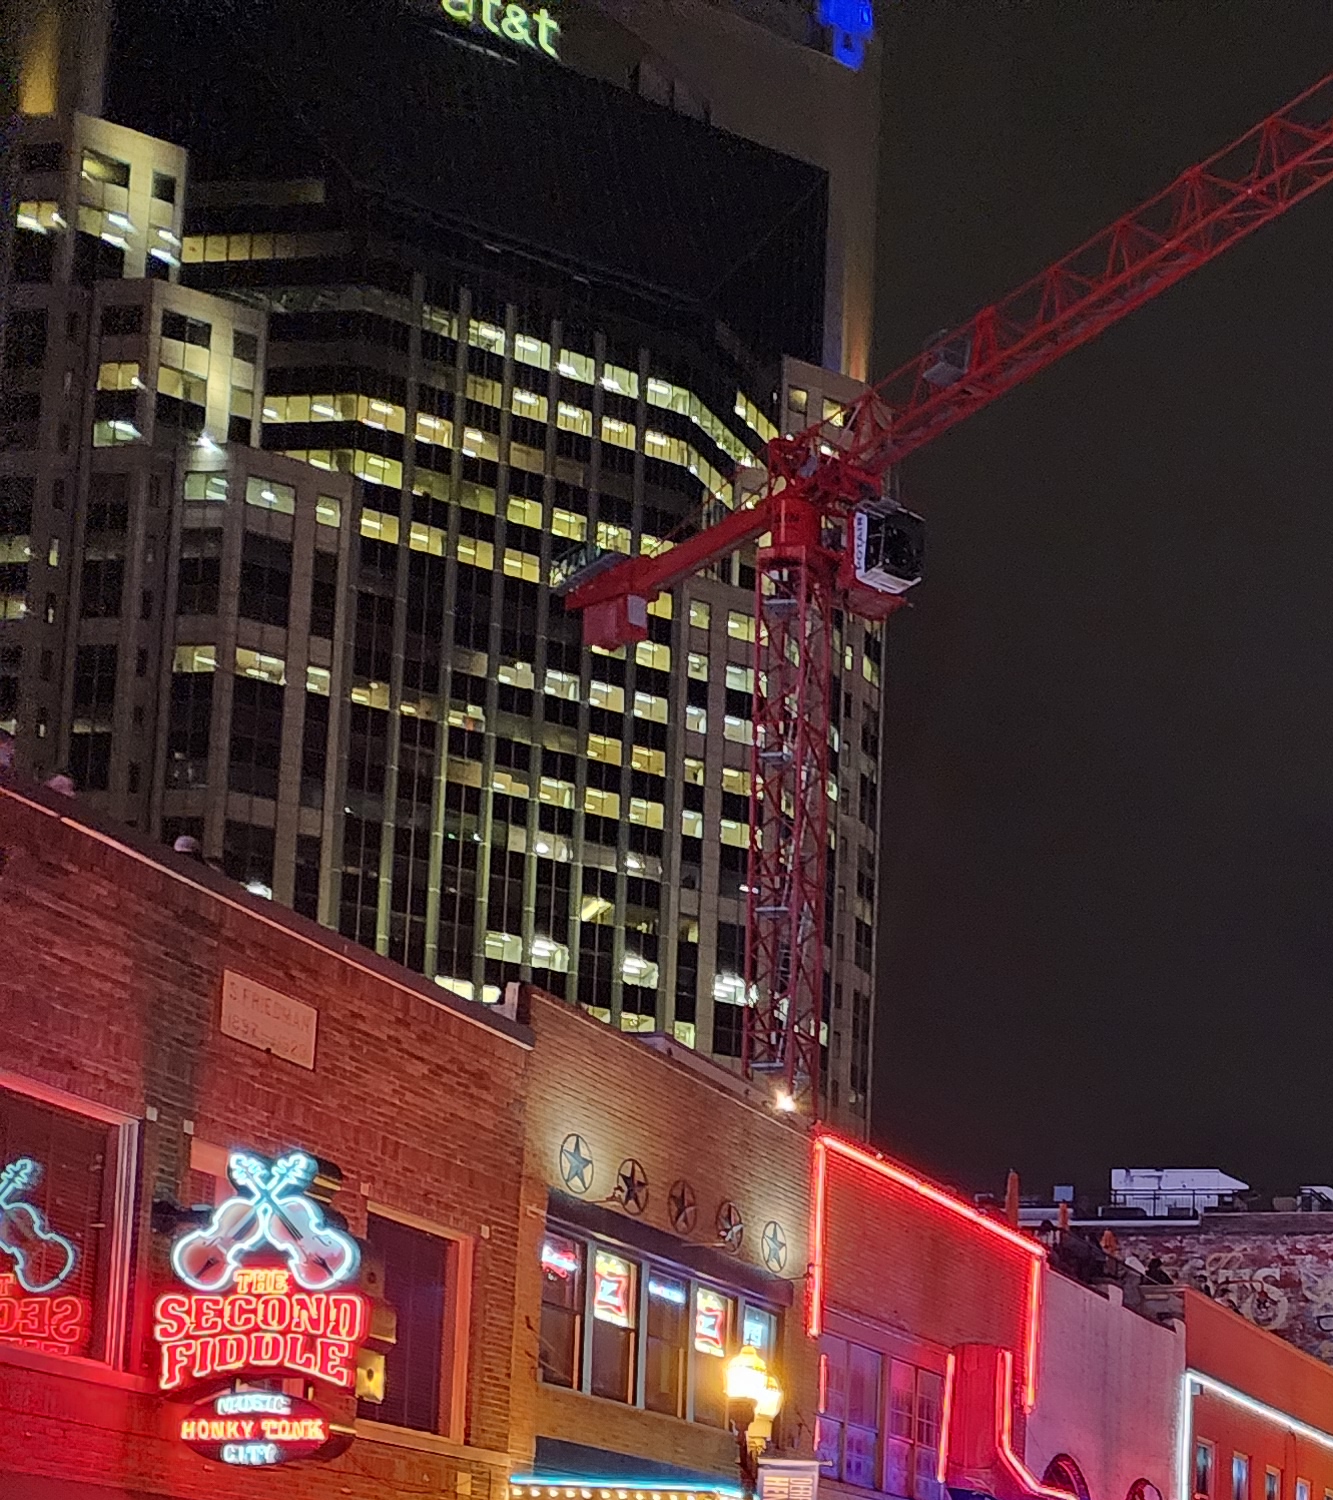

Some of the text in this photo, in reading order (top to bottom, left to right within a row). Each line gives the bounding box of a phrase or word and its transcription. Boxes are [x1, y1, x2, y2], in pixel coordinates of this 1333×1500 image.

[232, 1269, 289, 1294] THE
[154, 1294, 365, 1343] SECOND
[159, 1333, 351, 1390] FIDDLE
[215, 1395, 291, 1415] MUSIC
[180, 1419, 326, 1442] HONKY TONK
[221, 1442, 281, 1466] CITY
